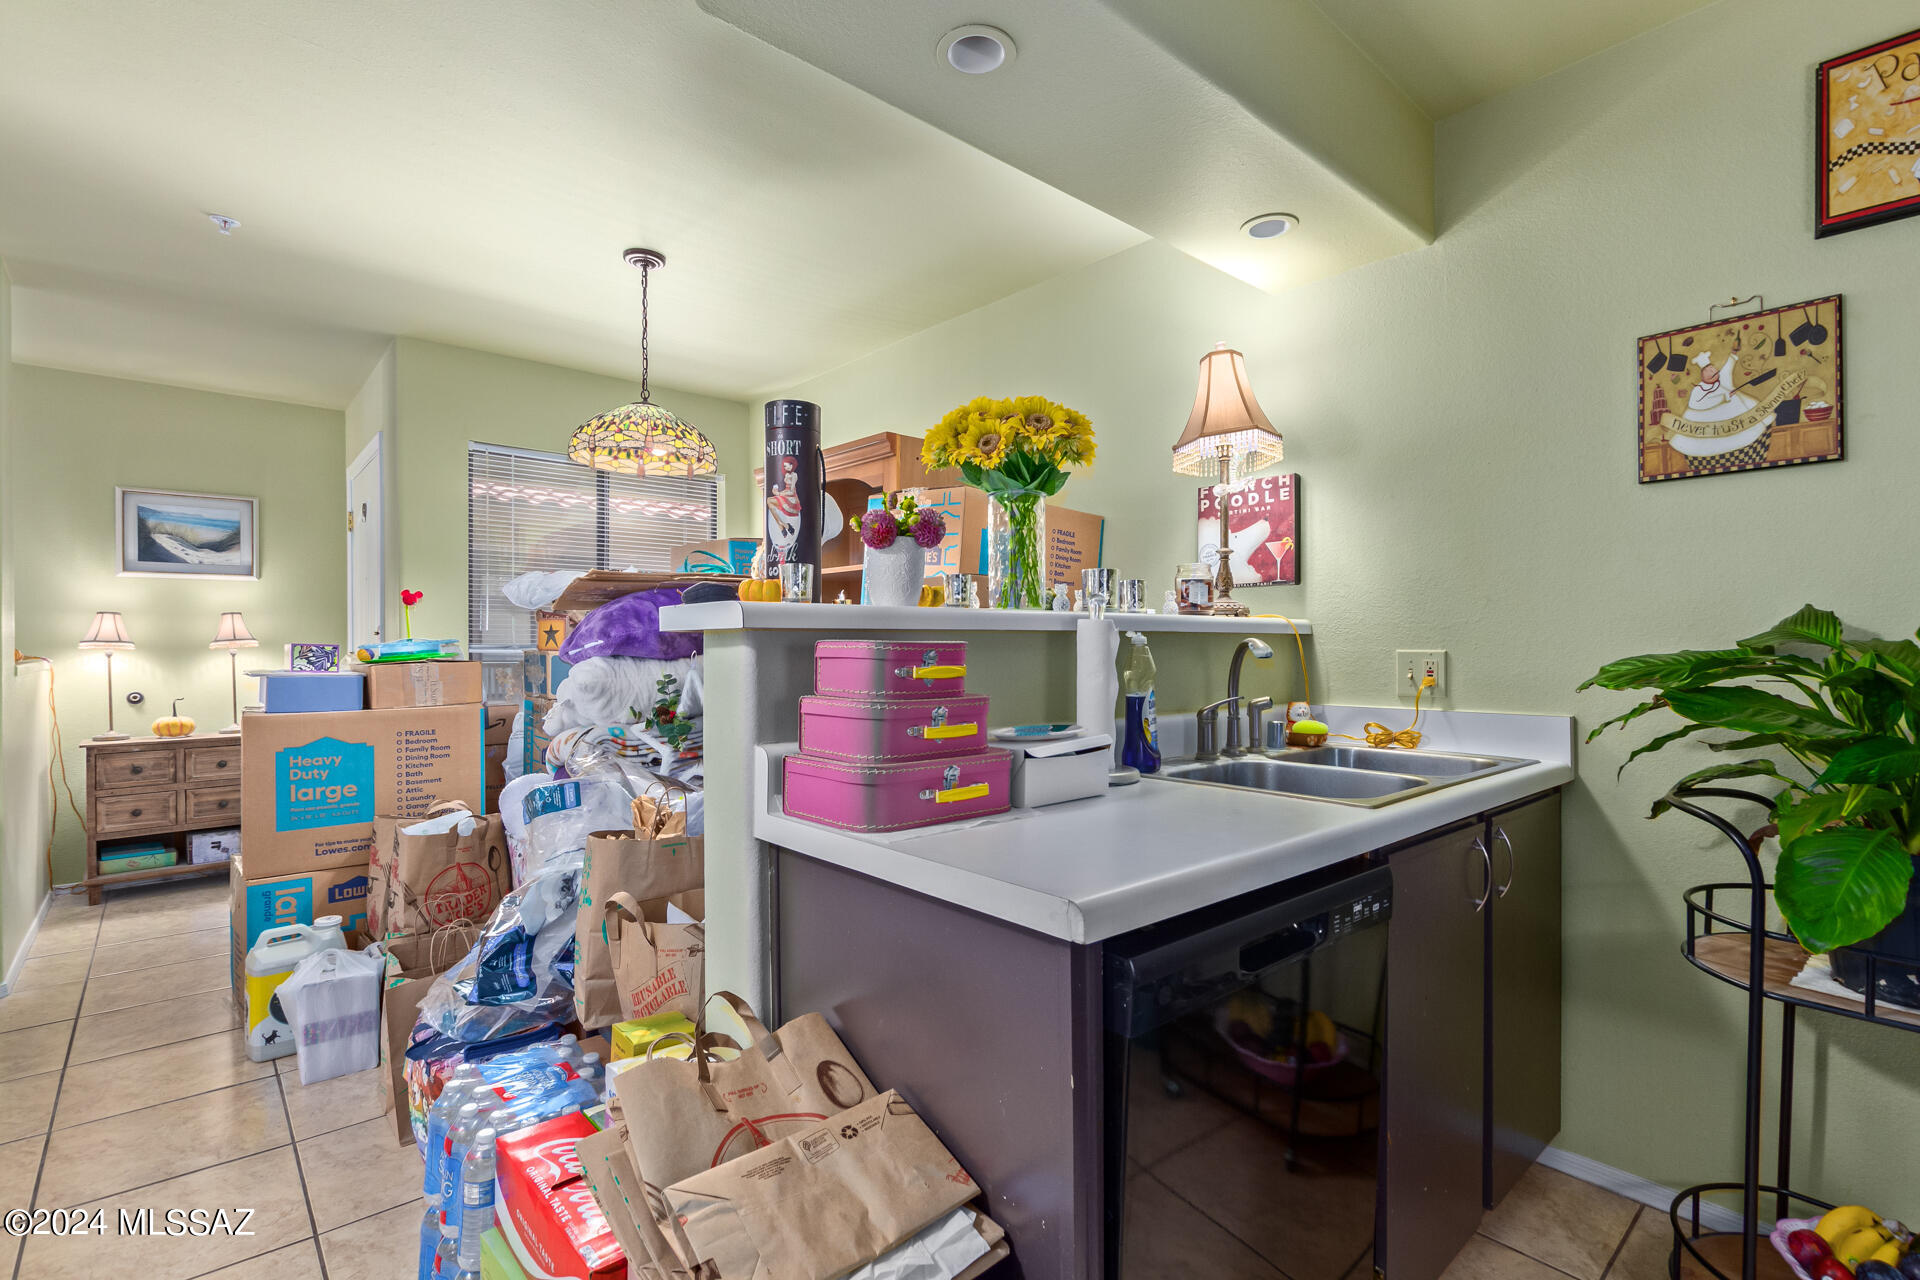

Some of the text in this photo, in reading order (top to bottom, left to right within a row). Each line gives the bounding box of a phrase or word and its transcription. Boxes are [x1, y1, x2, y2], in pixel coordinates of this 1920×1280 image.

[766, 404, 802, 427] LIFE
[1748, 415, 1758, 424] a
[766, 440, 802, 457] SHORT
[768, 566, 779, 577] GO
[405, 729, 436, 737] FRAGILE
[289, 755, 342, 768] Heavy
[289, 768, 330, 781] Duty
[405, 777, 442, 786] Basement
[290, 784, 358, 803] large
[405, 794, 436, 802] Laundry
[405, 803, 430, 811] Garag
[263, 890, 272, 922] grande
[526, 1166, 554, 1199] ORIGINAL
[549, 1197, 572, 1223] TASTE
